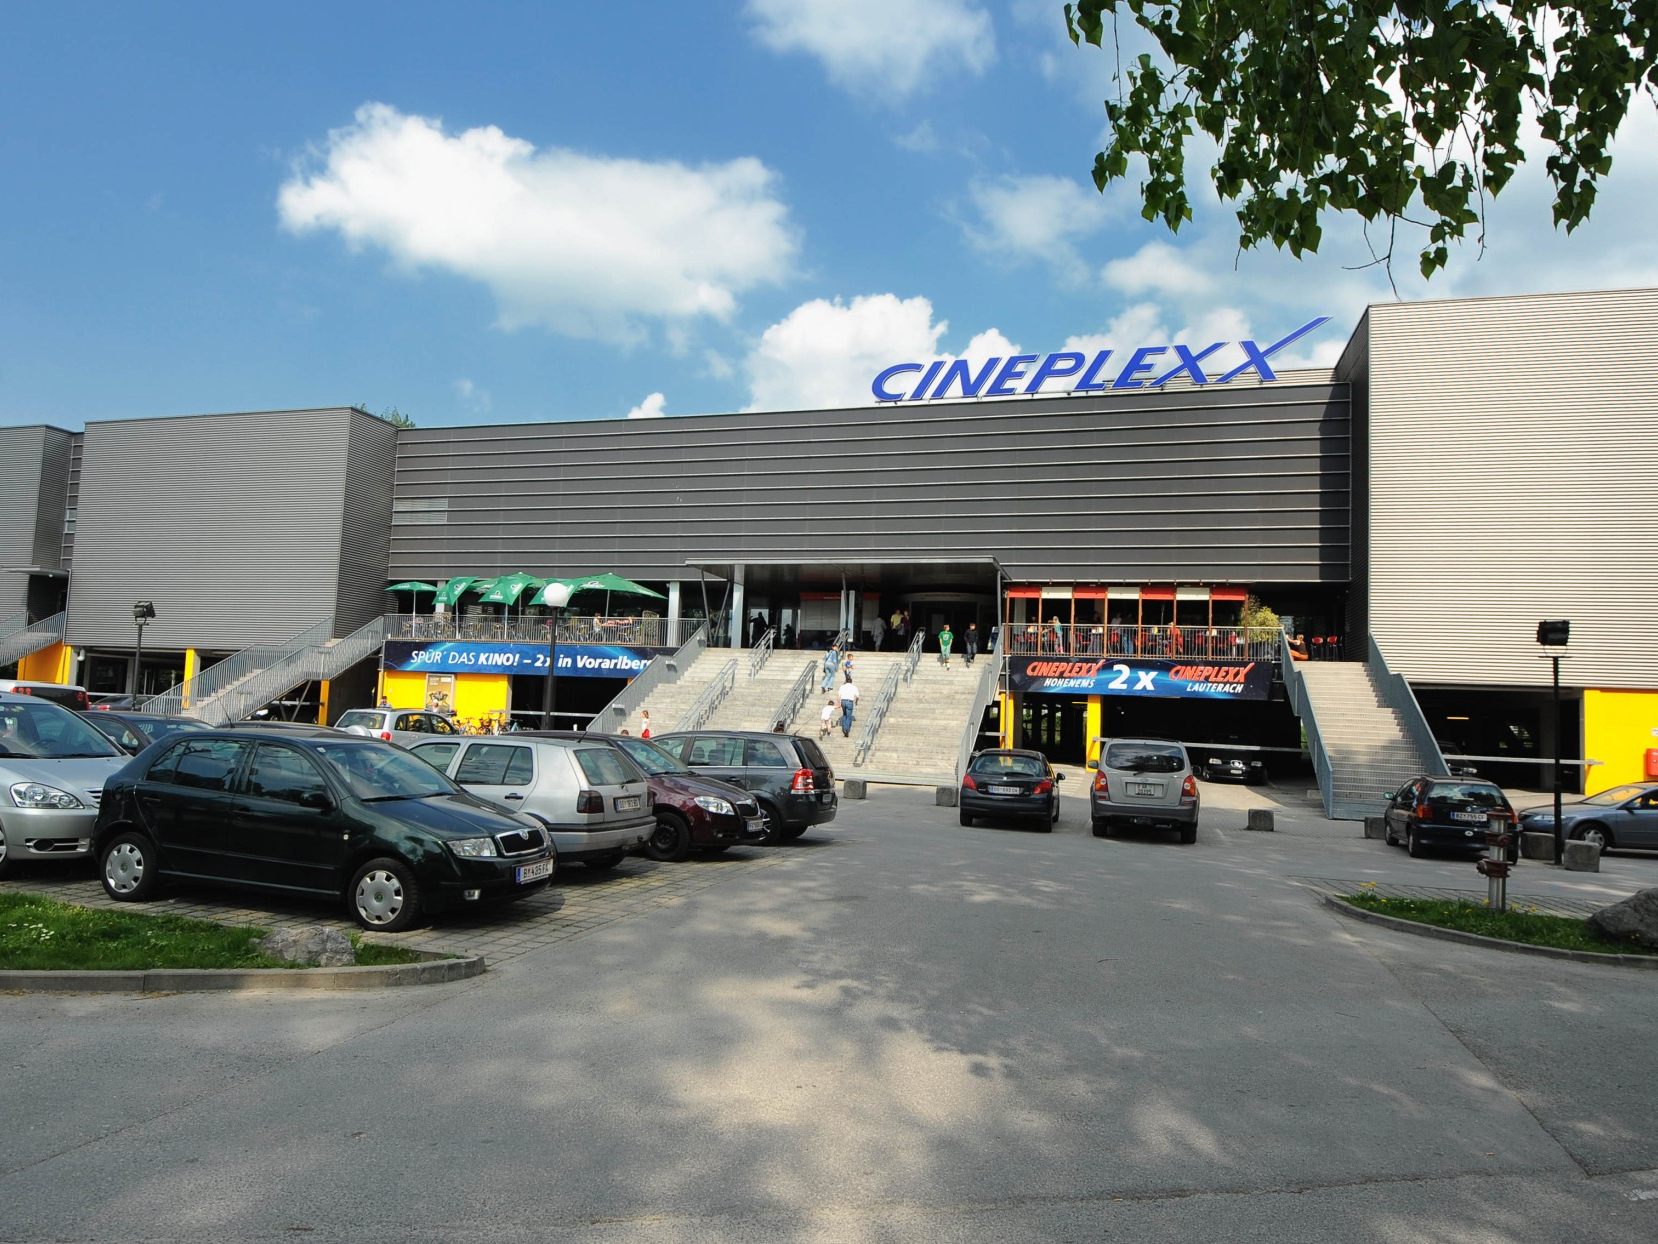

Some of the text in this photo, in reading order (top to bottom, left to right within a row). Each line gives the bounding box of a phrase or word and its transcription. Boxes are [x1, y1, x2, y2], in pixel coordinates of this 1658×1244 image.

[871, 316, 1333, 402] CINEPLEXX
[448, 652, 476, 665] DAS
[478, 653, 520, 666] KINO!
[557, 655, 572, 668] in
[1026, 659, 1106, 678] CINEPLEXX
[1169, 662, 1255, 682] CINEPLEXX
[1043, 678, 1096, 688] HOHENEMS
[1186, 683, 1244, 693] LAUTERACH
